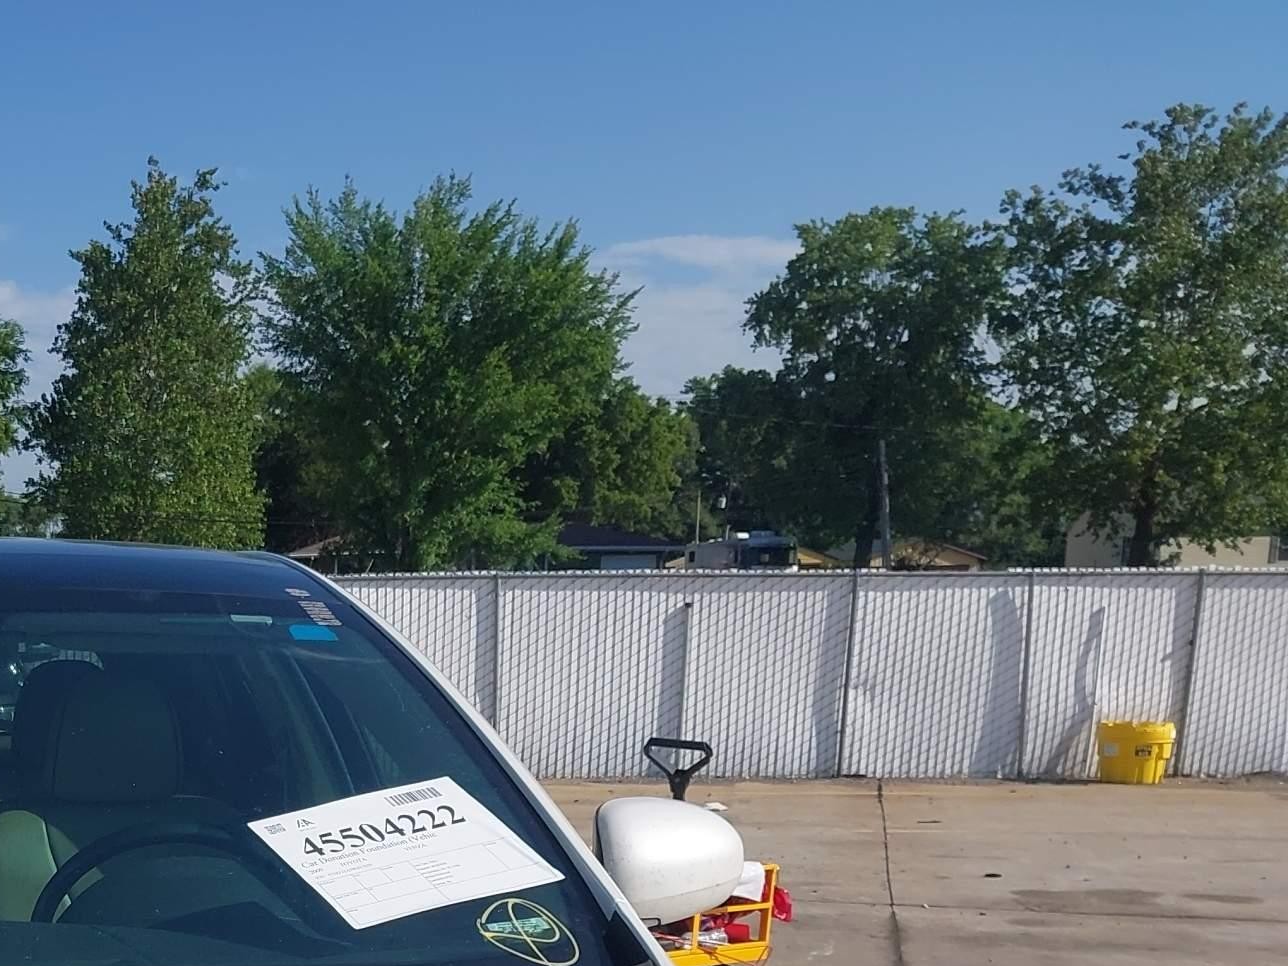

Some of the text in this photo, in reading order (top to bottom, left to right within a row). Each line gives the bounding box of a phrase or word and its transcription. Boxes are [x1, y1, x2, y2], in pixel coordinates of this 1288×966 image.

[303, 804, 466, 857] 45504222
[301, 860, 319, 869] Car
[319, 850, 359, 864] Donation
[360, 838, 408, 855] Foundation
